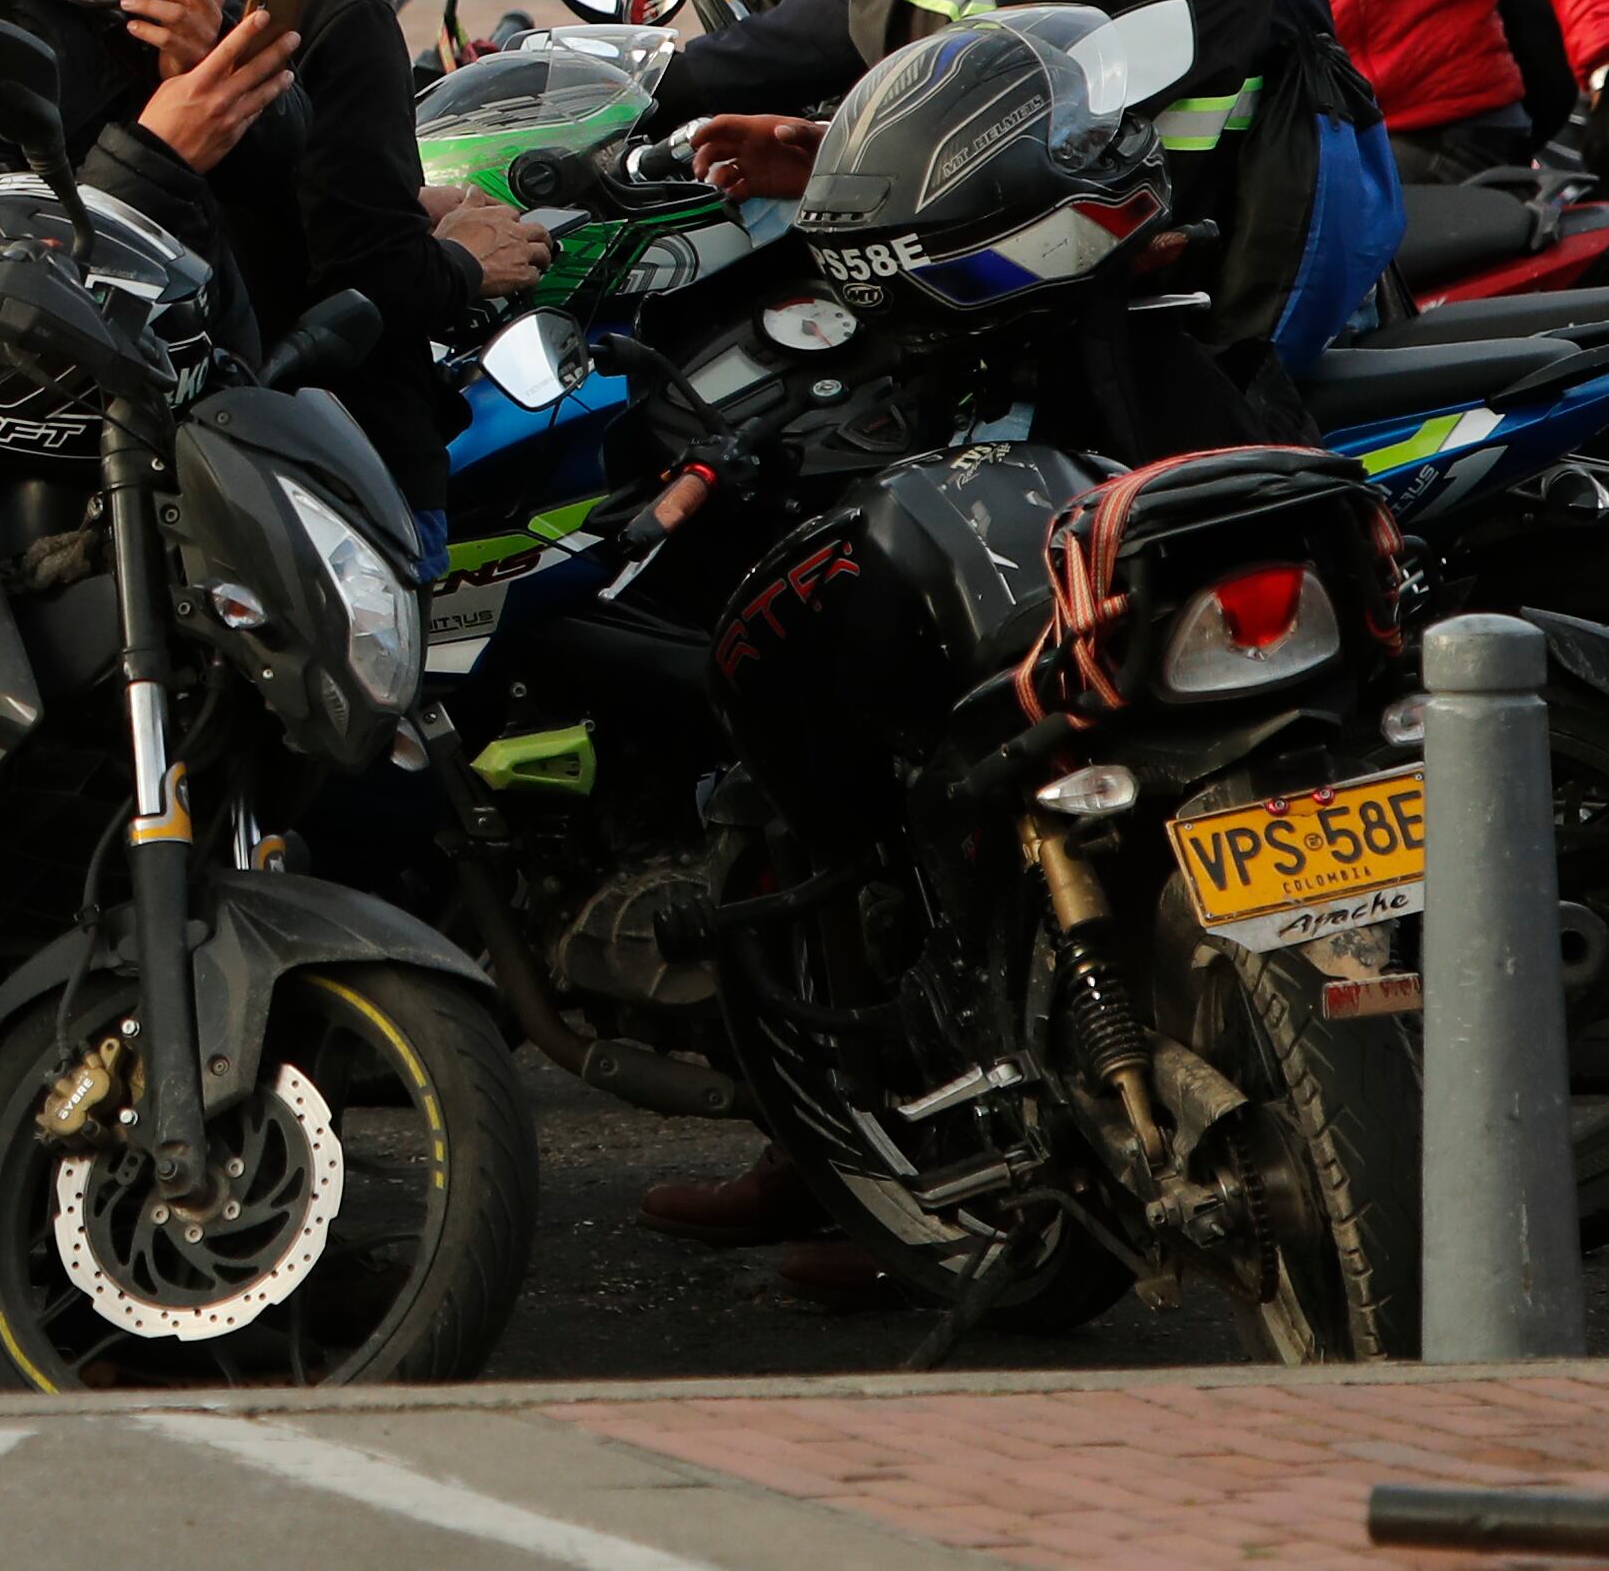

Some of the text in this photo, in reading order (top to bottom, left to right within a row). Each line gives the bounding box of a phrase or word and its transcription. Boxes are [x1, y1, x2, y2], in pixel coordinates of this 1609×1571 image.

[1188, 789, 1425, 893] VPS 58E
[1283, 865, 1373, 894] COLOMBIA
[1278, 890, 1411, 938] Apache
